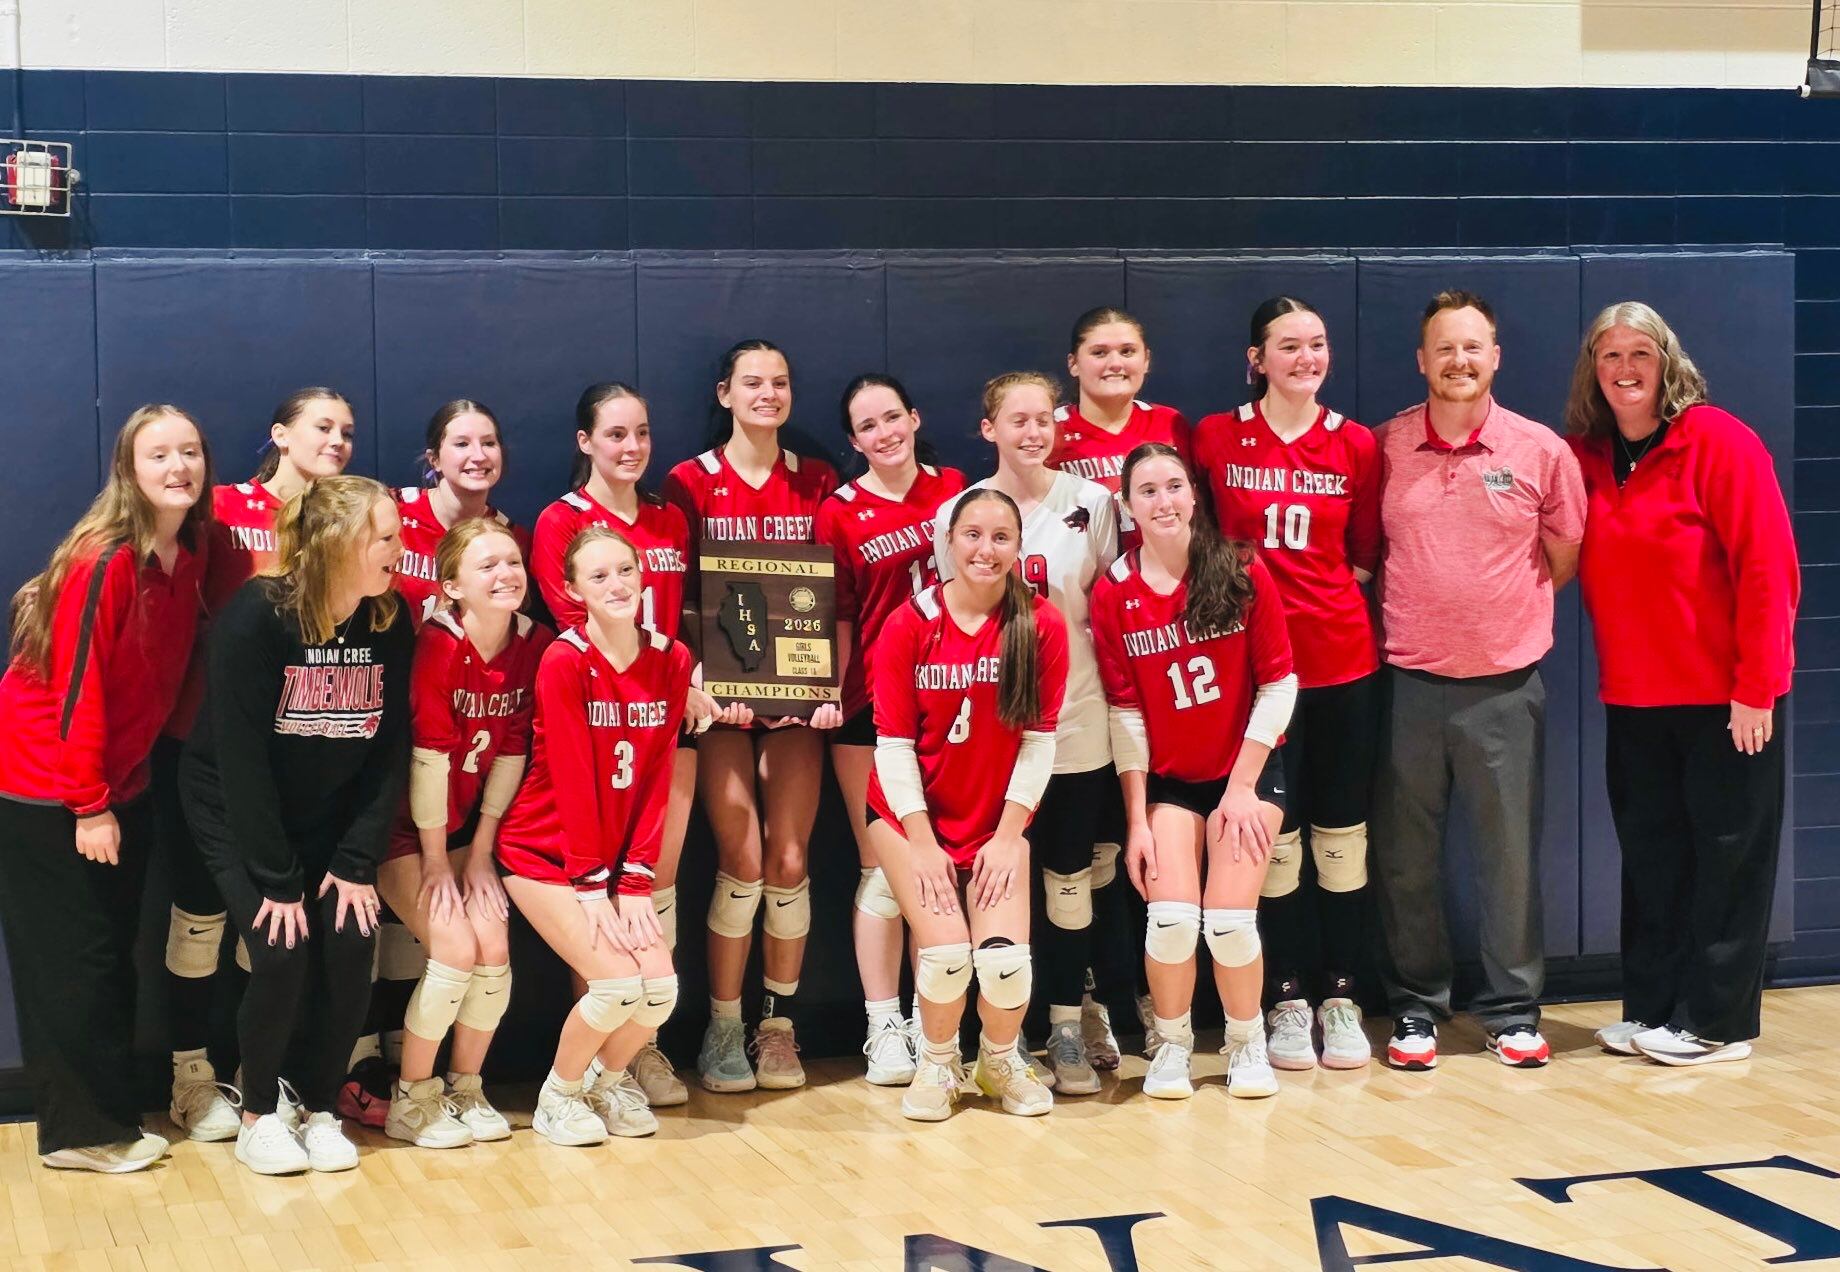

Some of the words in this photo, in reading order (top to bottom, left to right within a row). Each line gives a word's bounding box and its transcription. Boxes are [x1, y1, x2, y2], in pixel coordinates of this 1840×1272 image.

[1226, 463, 1286, 492] INDIAN
[1292, 469, 1349, 495] CREEK
[229, 525, 278, 551] INDI
[702, 516, 757, 541] INDIAN
[763, 515, 813, 541] CREEK
[1263, 503, 1311, 550] 10
[859, 525, 922, 564] INDIAN
[717, 559, 819, 574] REGIONAL
[1012, 554, 1049, 598] 9
[784, 618, 821, 632] 2026
[795, 642, 812, 651] GIRLS
[1122, 623, 1181, 657] INDIAN
[305, 648, 340, 664] INDIAN
[343, 647, 373, 664] CREE
[787, 653, 821, 664] VOLLEYBALL
[792, 667, 808, 675] CLASS
[915, 663, 973, 690] INDIAN
[1166, 655, 1221, 710] 12
[711, 683, 832, 699] CHAMPIONS
[461, 729, 491, 774] 2
[611, 740, 634, 789] 3
